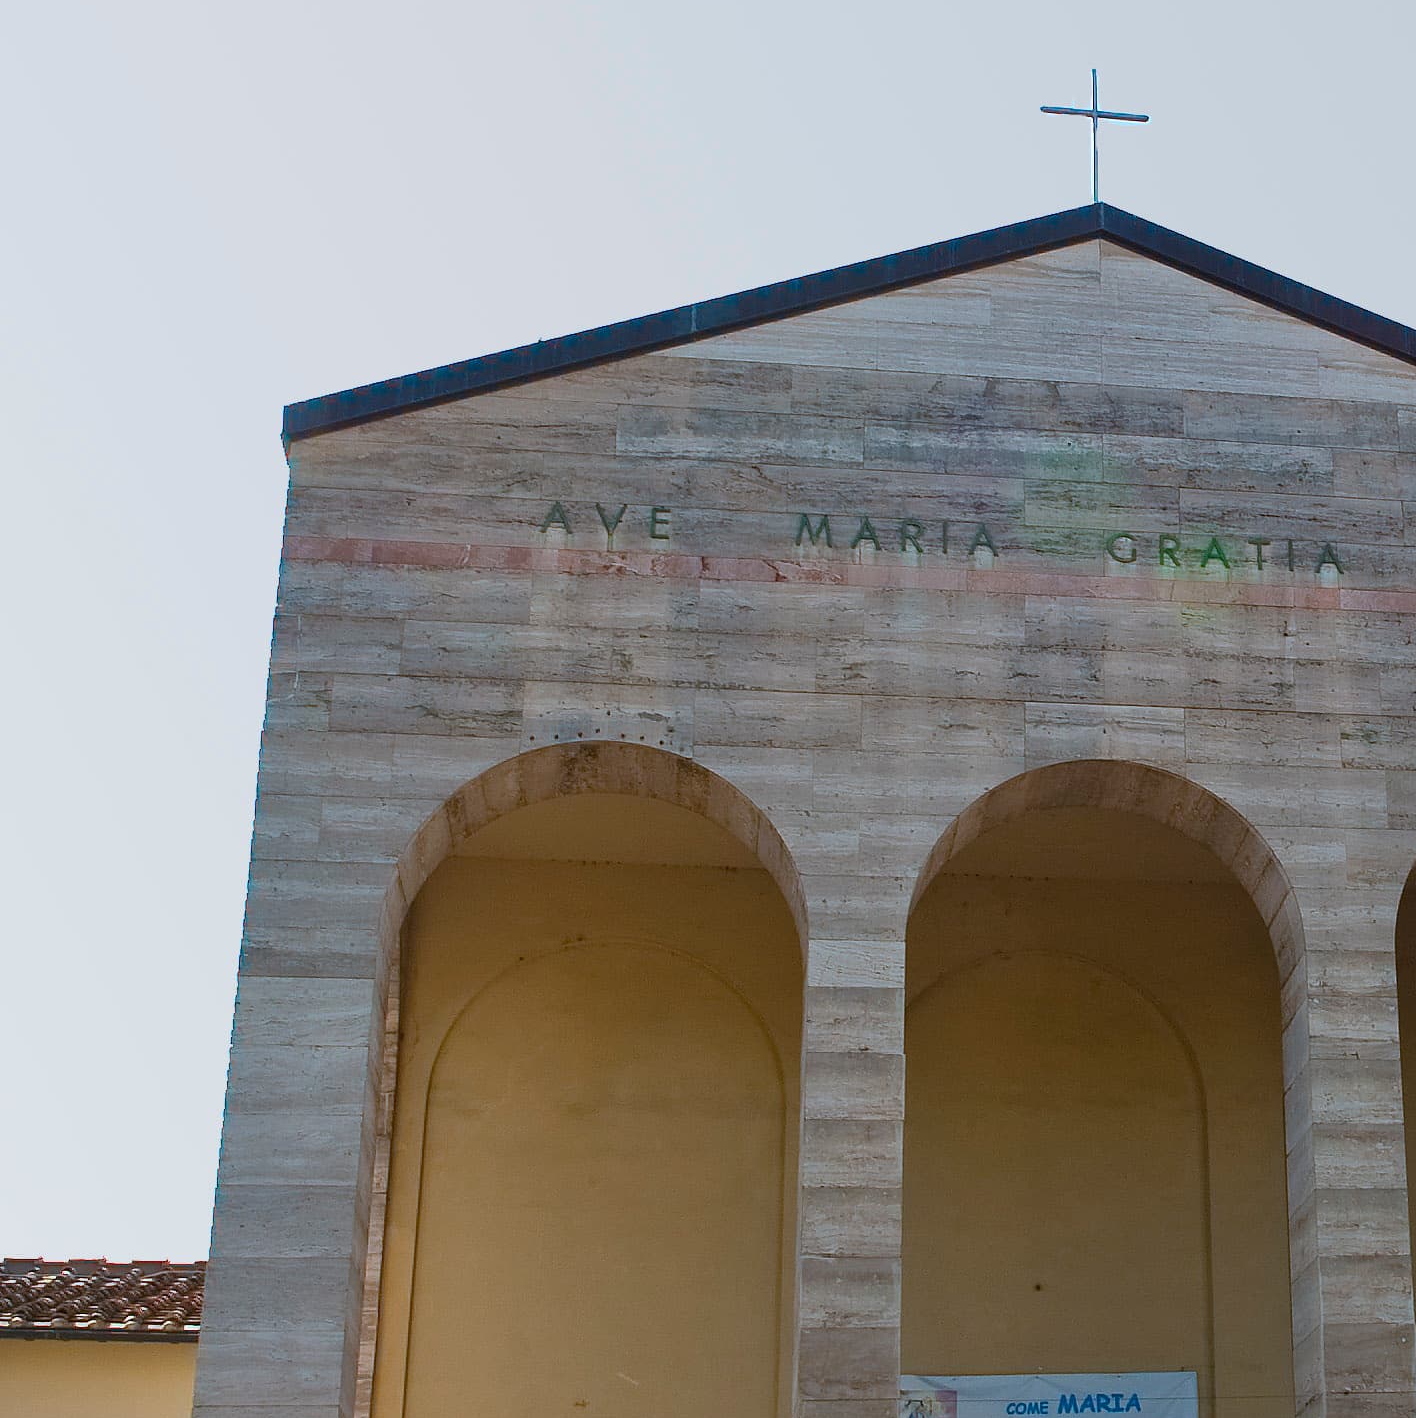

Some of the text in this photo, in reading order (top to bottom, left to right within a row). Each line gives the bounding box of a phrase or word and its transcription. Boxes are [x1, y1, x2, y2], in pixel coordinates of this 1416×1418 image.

[541, 501, 671, 541] AVE
[795, 513, 999, 557] MARIA
[1106, 532, 1345, 575] GRATIA
[1006, 1393, 1142, 1415] COME MARIA
